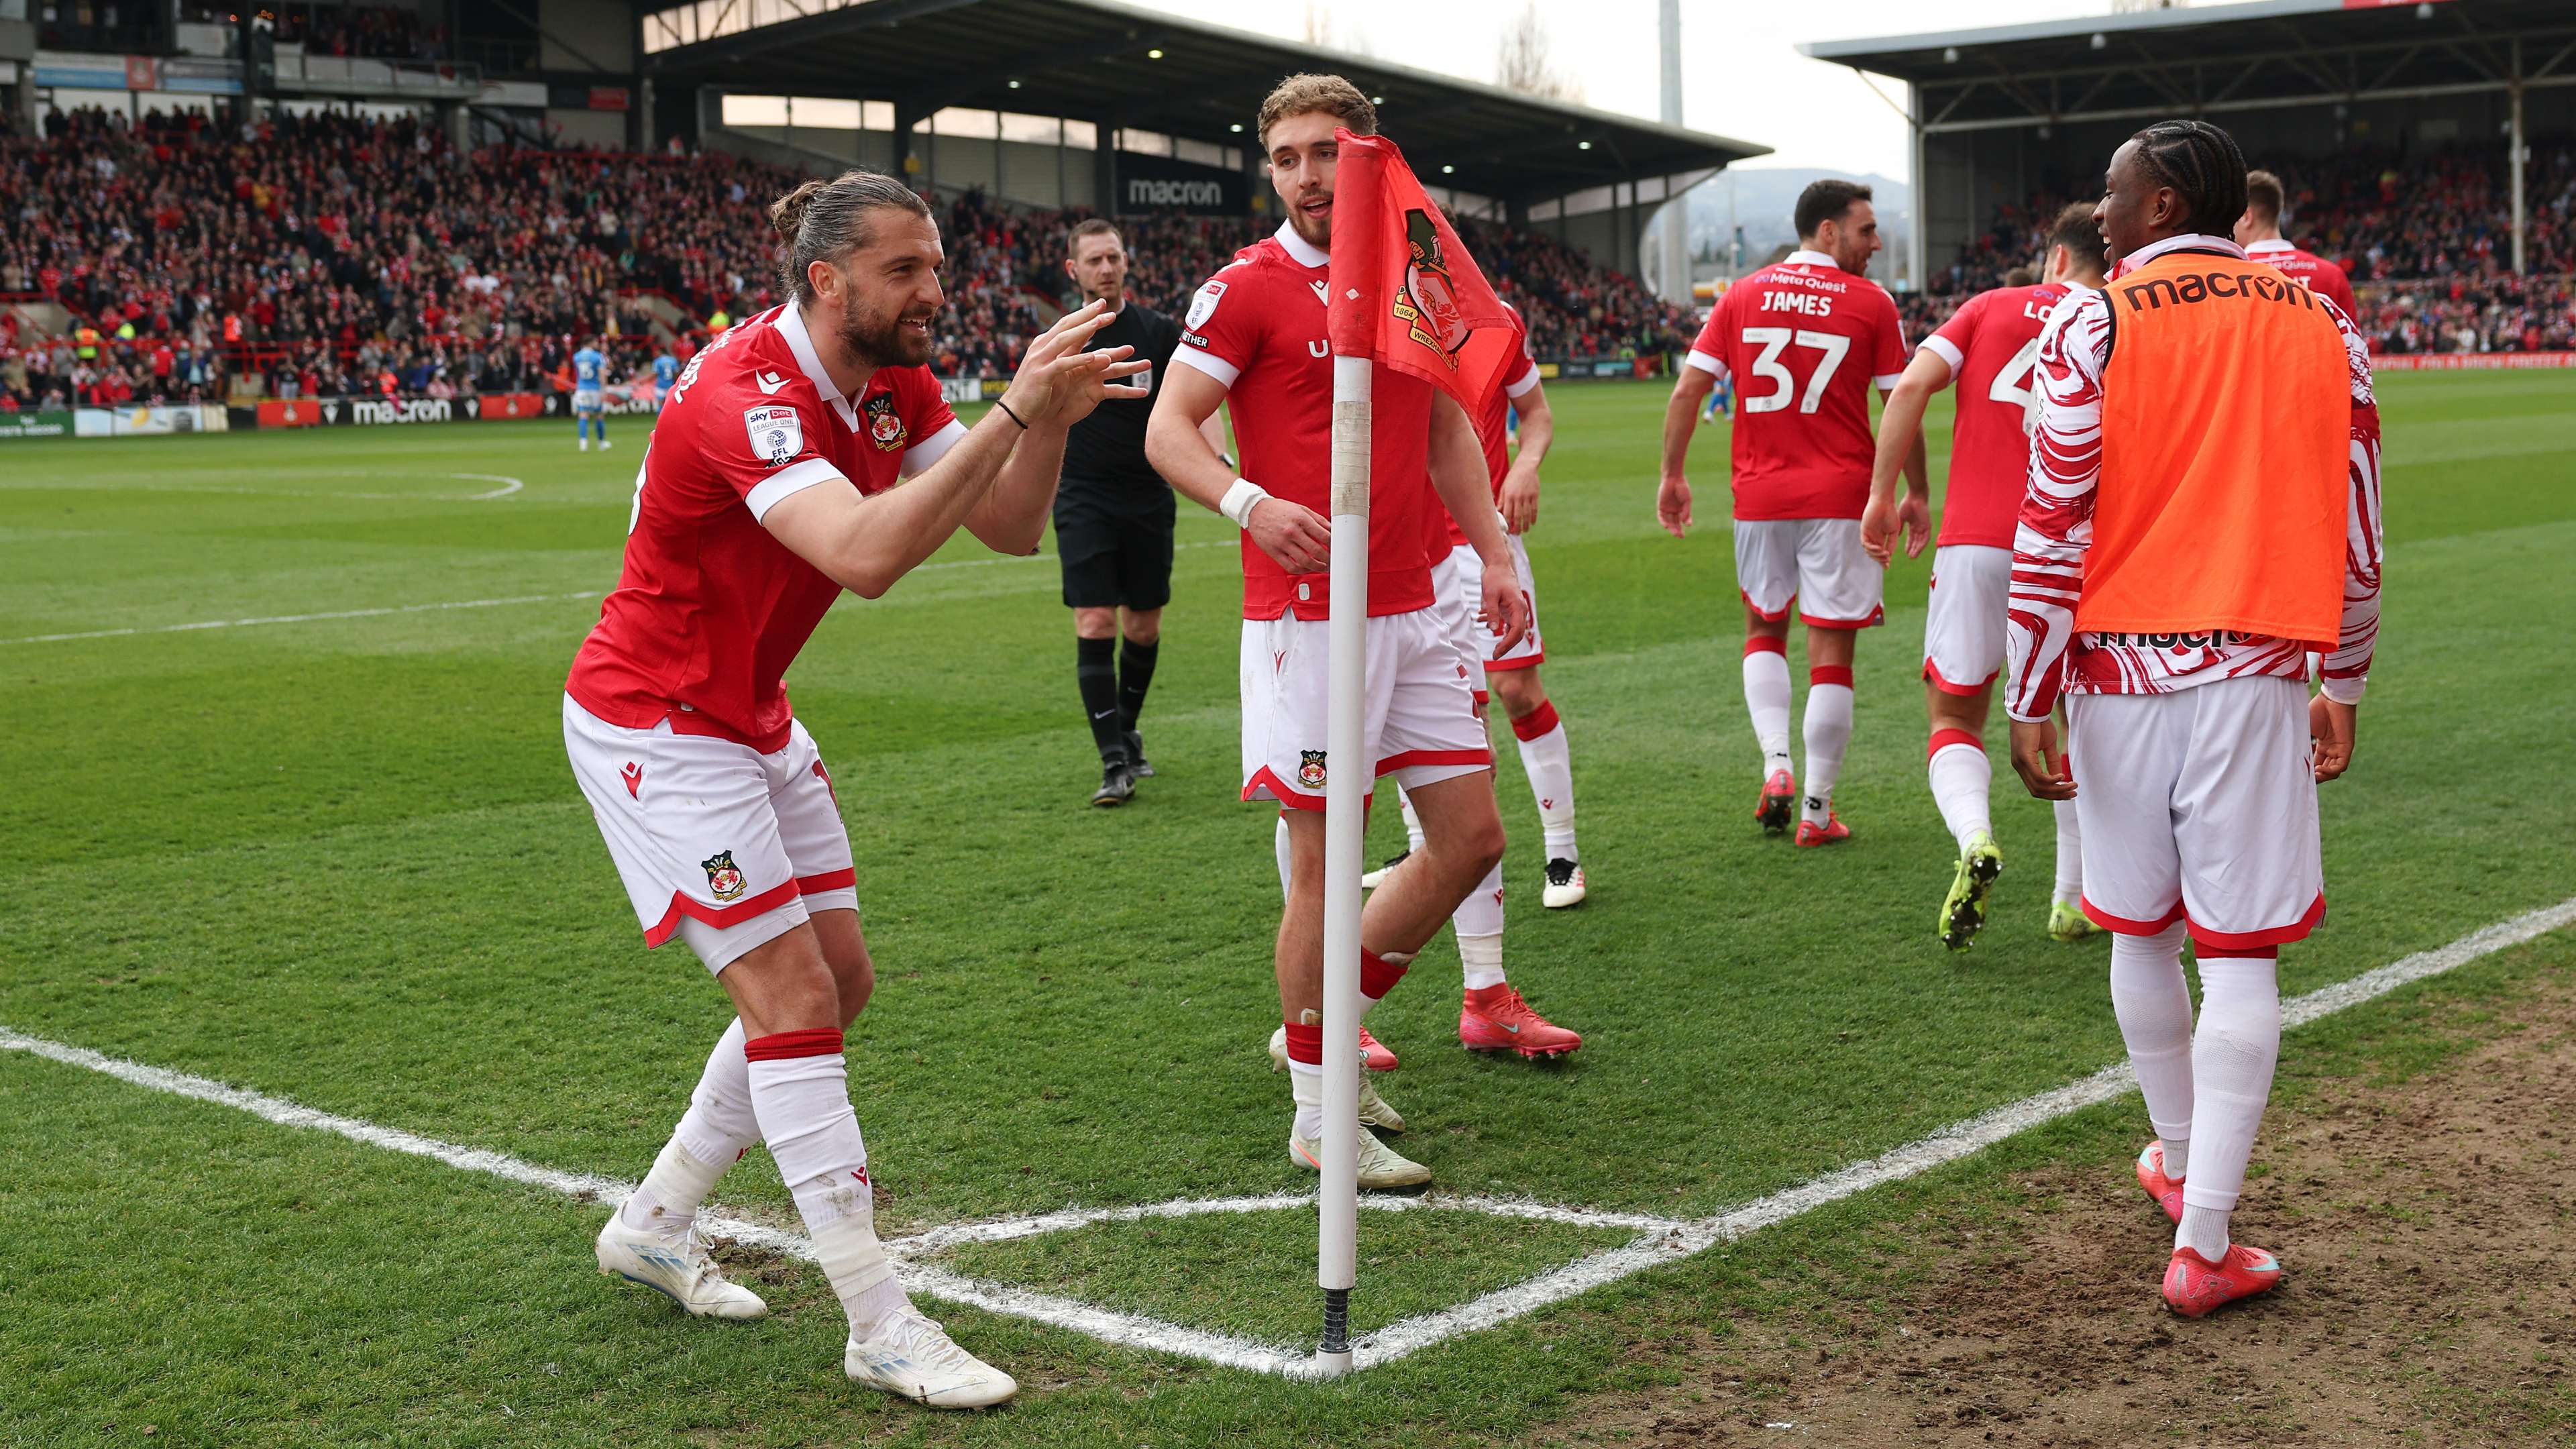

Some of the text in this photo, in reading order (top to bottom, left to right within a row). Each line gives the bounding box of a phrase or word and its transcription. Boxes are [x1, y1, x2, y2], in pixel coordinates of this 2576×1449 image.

[1129, 180, 1222, 205] macron
[1770, 272, 1847, 294] Meta Quest
[2123, 273, 2314, 311] macron
[1396, 307, 1413, 317] 1864
[1760, 290, 1833, 317] JAMES
[1414, 331, 1444, 357] WREXHAM
[1741, 327, 1851, 414] 37
[353, 398, 452, 424] macron
[750, 412, 768, 423] sky
[753, 420, 779, 431] LEAGUE
[772, 447, 788, 458] EFL
